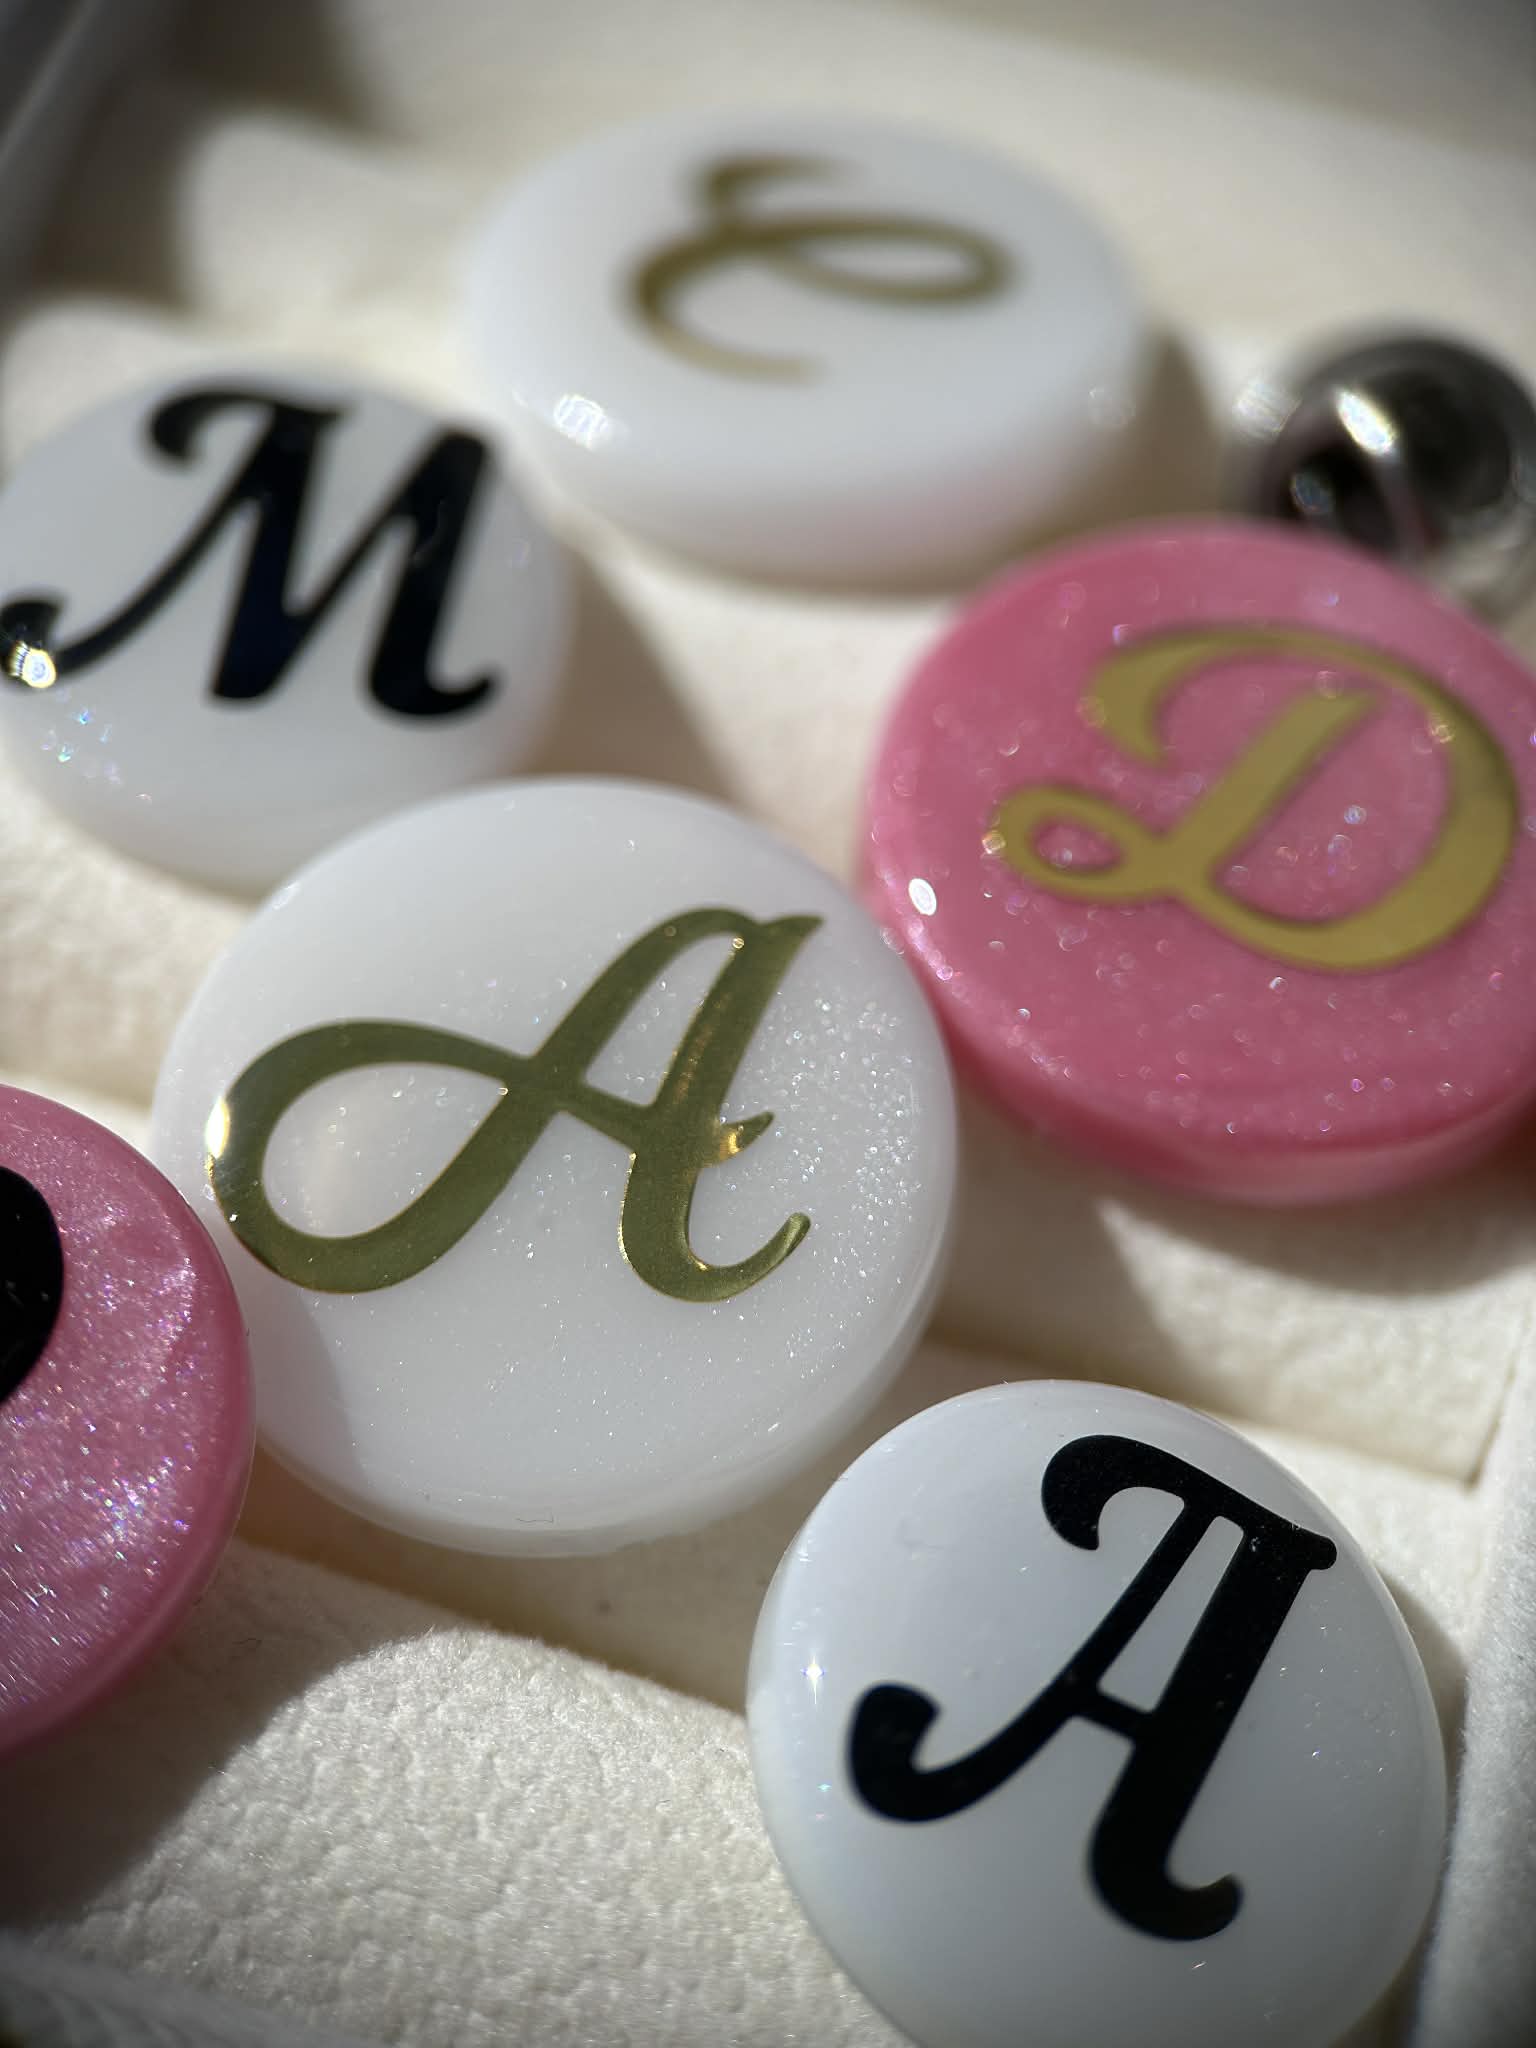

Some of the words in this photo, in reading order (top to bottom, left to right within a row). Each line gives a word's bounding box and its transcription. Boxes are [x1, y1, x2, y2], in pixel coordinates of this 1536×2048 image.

[626, 155, 1018, 384] E
[0, 381, 500, 720] M
[995, 625, 1520, 971] D
[207, 906, 824, 1302] A
[847, 1435, 1338, 1942] A
